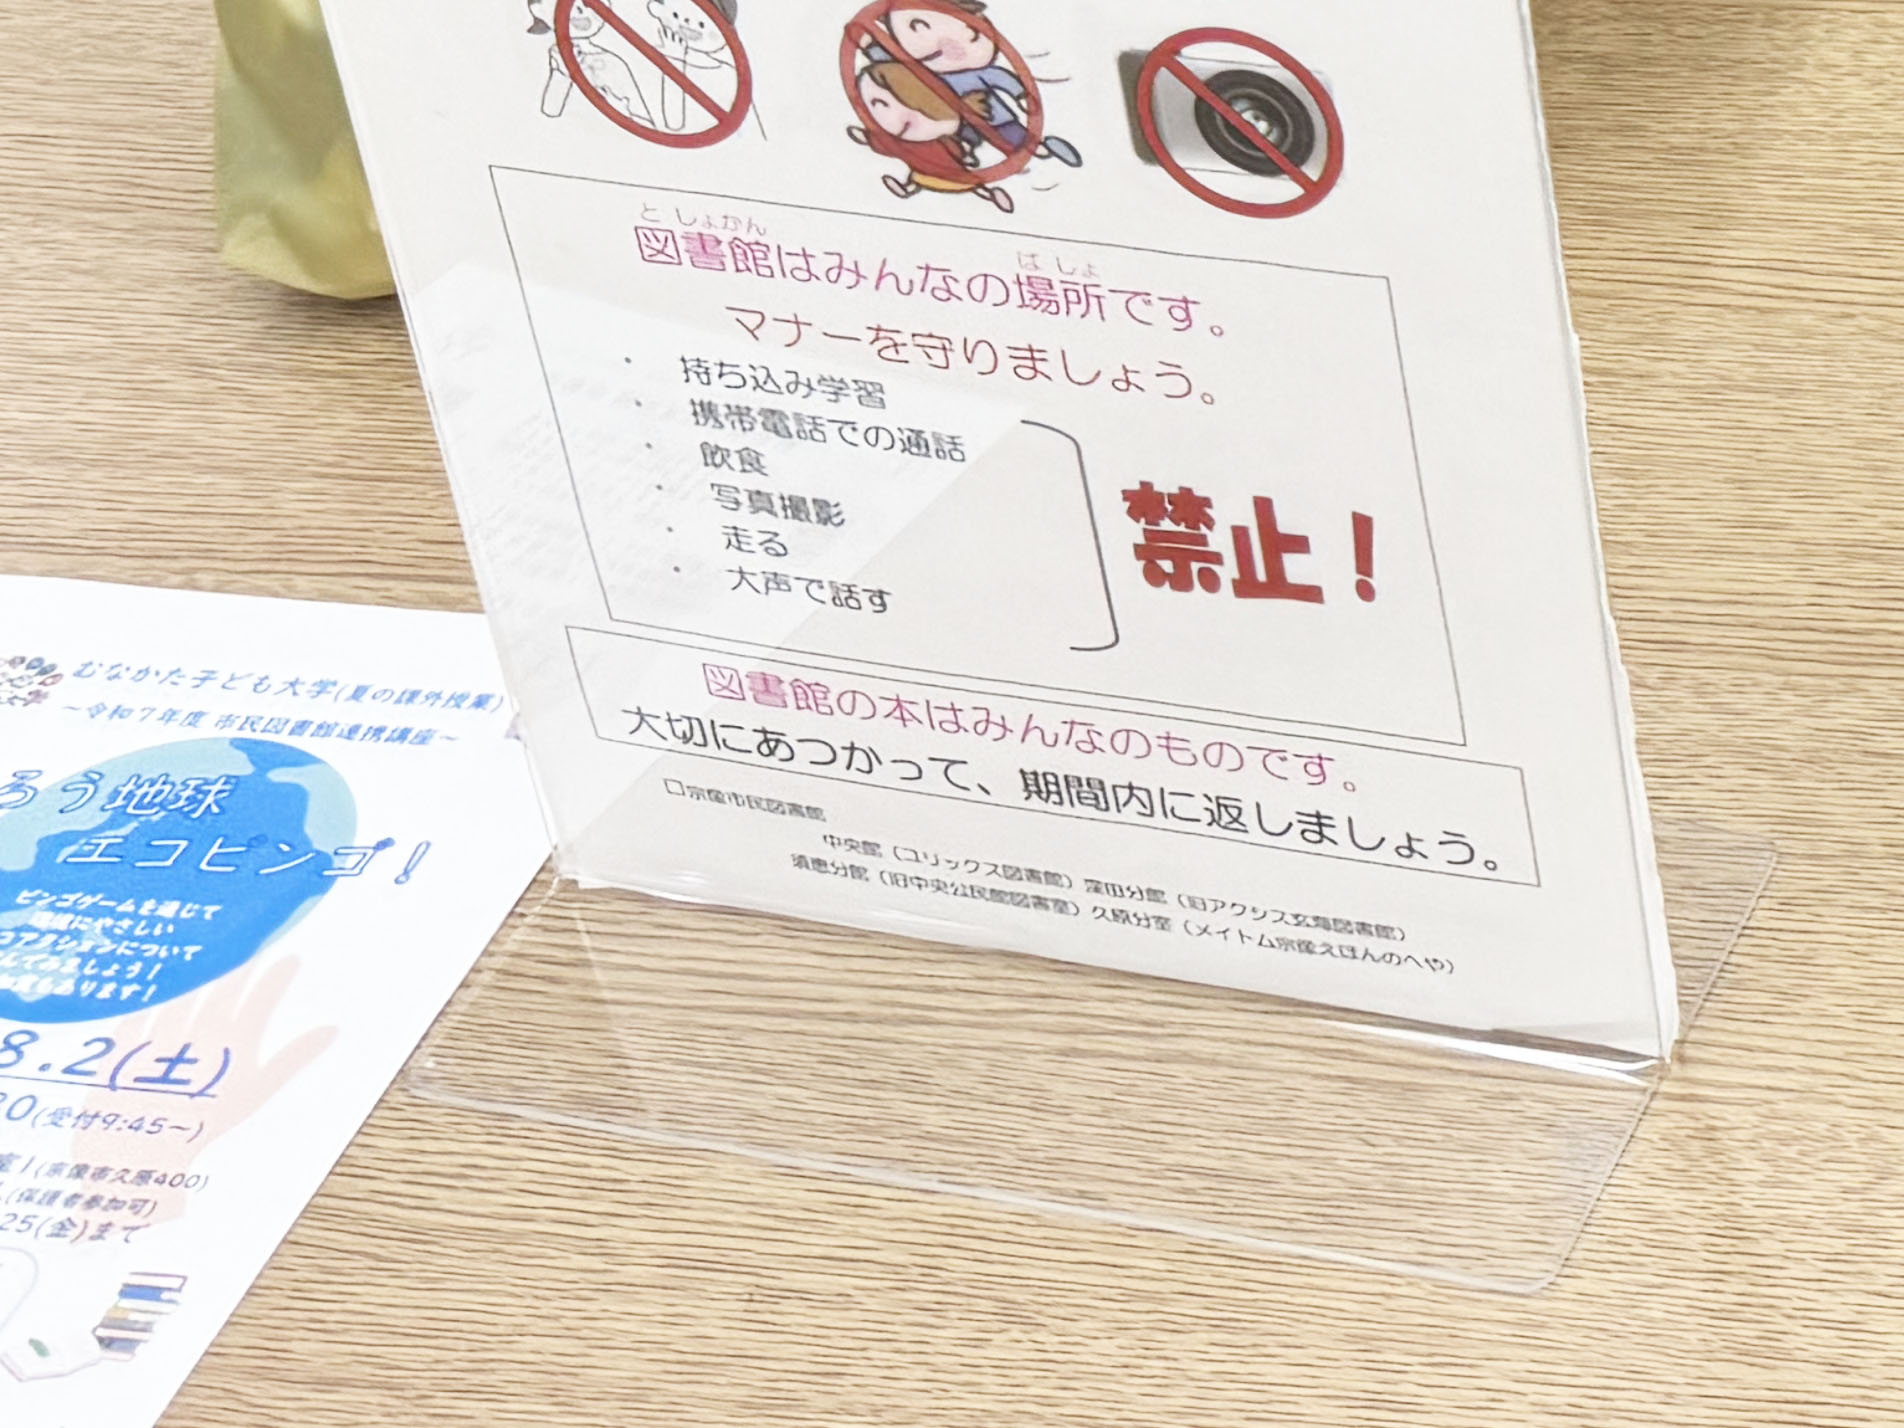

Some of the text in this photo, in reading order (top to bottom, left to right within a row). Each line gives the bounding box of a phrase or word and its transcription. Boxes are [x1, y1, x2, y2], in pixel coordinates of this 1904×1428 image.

[634, 224, 1228, 338] 図書館はみんなの場所です。
[680, 356, 888, 411] 持ち込み学習
[724, 302, 1219, 406] マナーを守りましょう。
[688, 399, 967, 464] 携帯電話での通話
[701, 442, 769, 478] 飲食
[709, 482, 846, 529] 写真撮影
[723, 523, 790, 560] 走る
[727, 564, 893, 614] 大声で話す
[702, 661, 1357, 796] 図書館の本はみんなのものです。
[622, 703, 1500, 873] 大切にあつかって、期間内に返しましょう。
